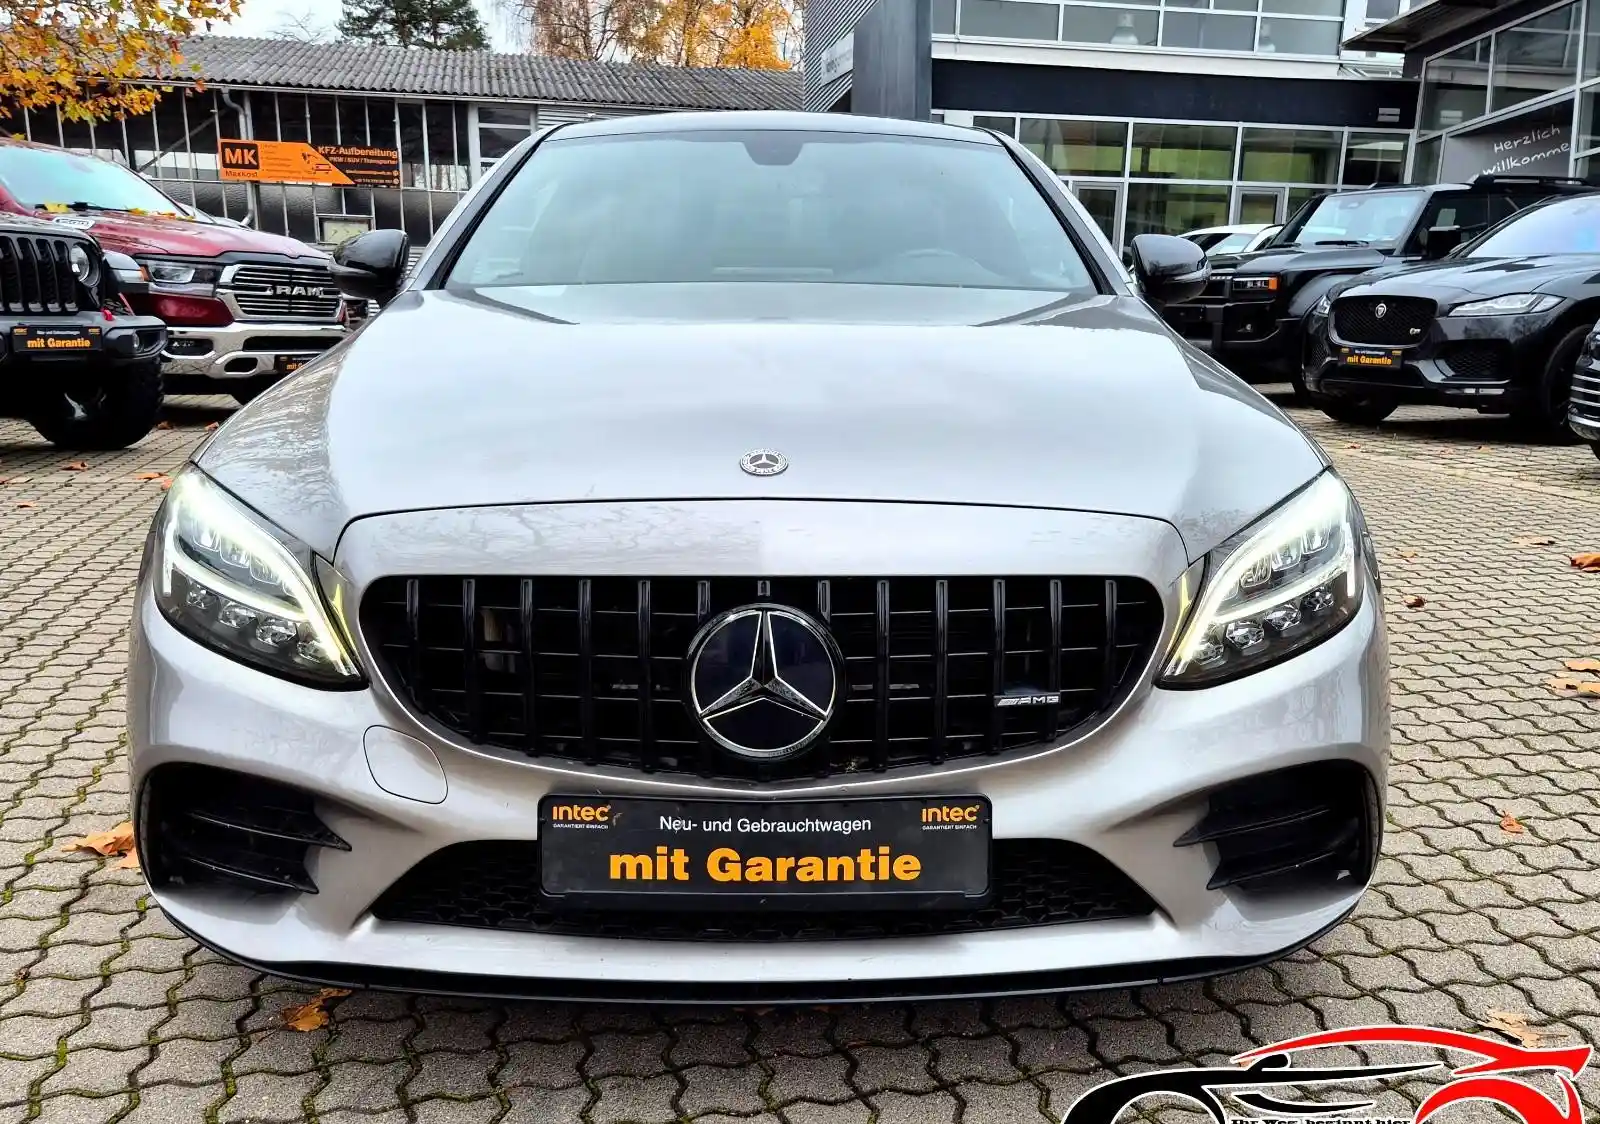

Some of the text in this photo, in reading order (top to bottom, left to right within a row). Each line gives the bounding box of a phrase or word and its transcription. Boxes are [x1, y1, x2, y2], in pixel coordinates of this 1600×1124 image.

[1493, 124, 1560, 153] Herzlich
[224, 147, 257, 166] MK
[318, 146, 398, 159] KFZ-Aufbereitung
[276, 285, 321, 296] RAM
[27, 337, 91, 348] mit Garantie
[1347, 355, 1392, 365] mit Garantie
[1016, 695, 1059, 705] AMG
[552, 804, 610, 821] intec
[921, 805, 978, 822] intec
[659, 816, 871, 835] Neu- und Gebrauchtwagen
[609, 845, 921, 882] mit Garantie
